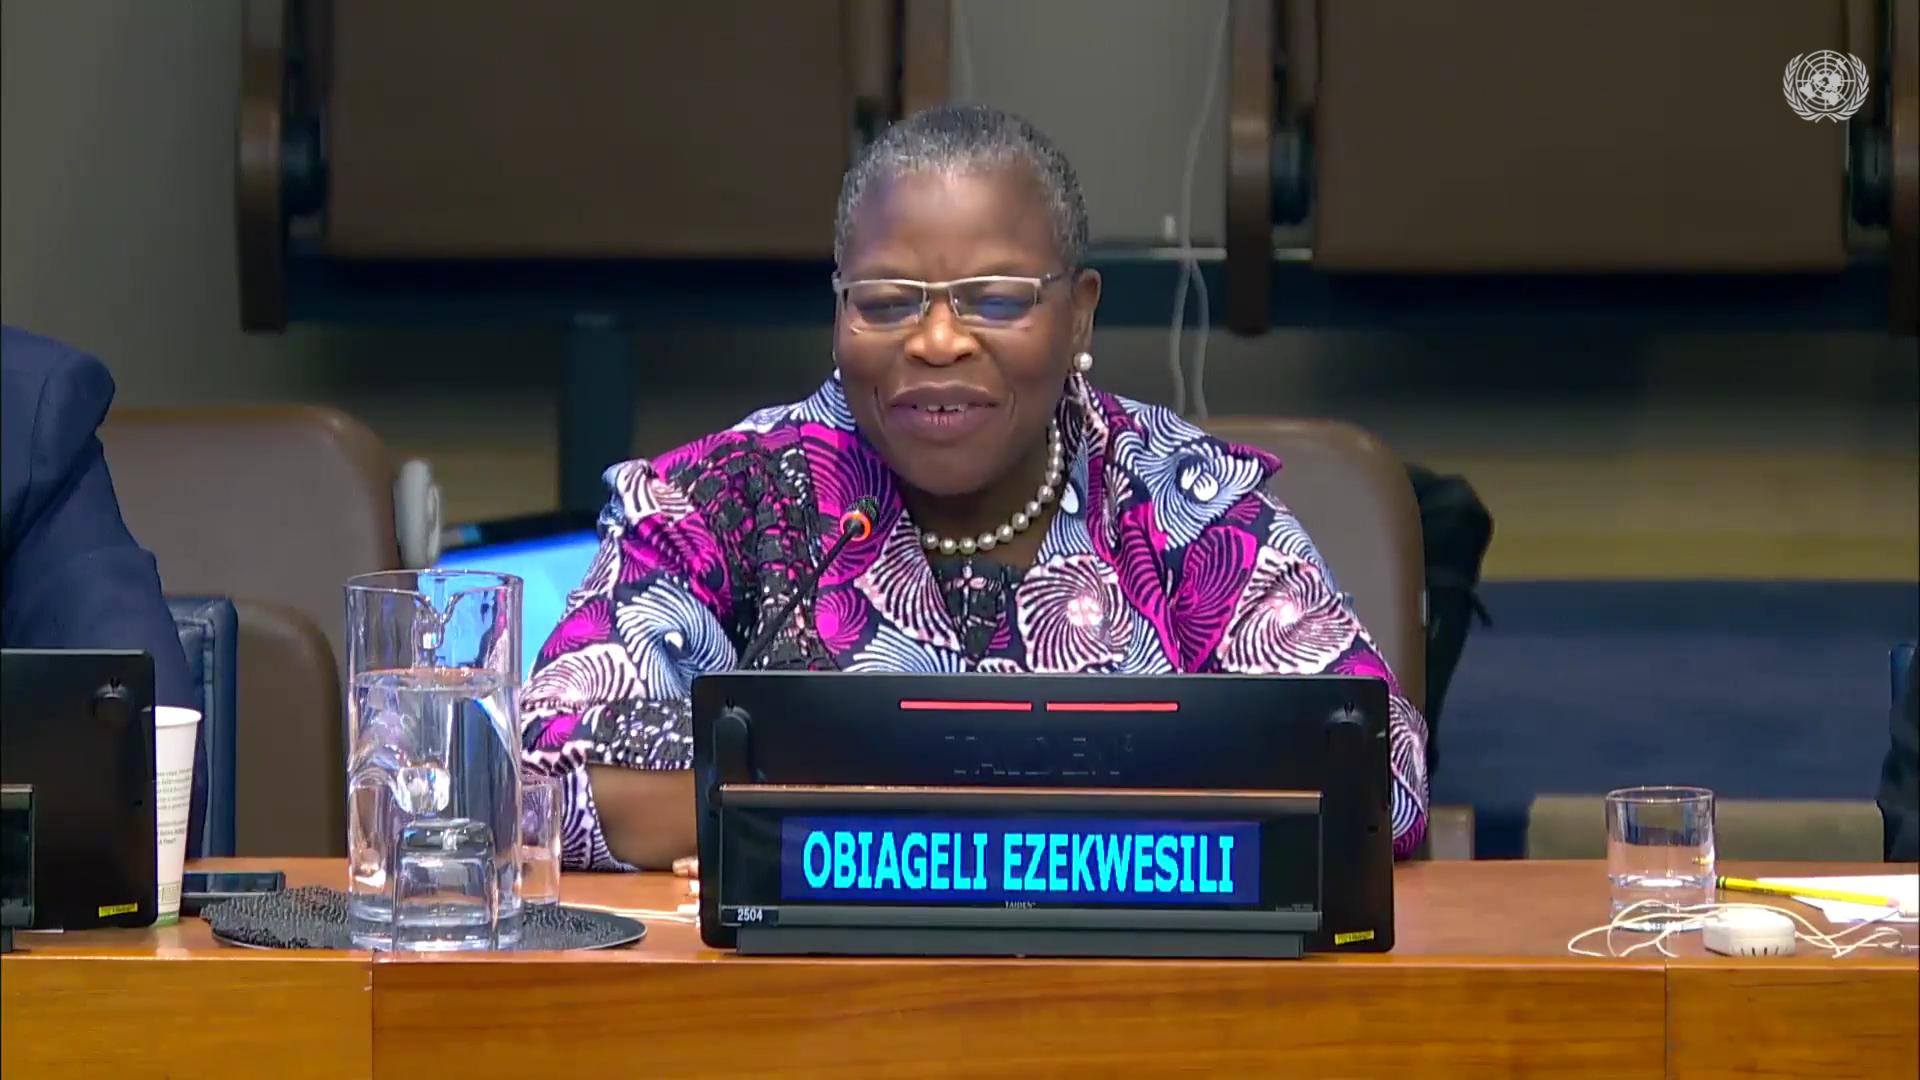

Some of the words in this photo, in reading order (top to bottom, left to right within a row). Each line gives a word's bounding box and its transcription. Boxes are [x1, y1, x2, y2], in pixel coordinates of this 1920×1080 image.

[803, 831, 987, 889] OBIAGELI
[1003, 833, 1234, 892] EZEKWESILI
[737, 907, 763, 922] 2504
